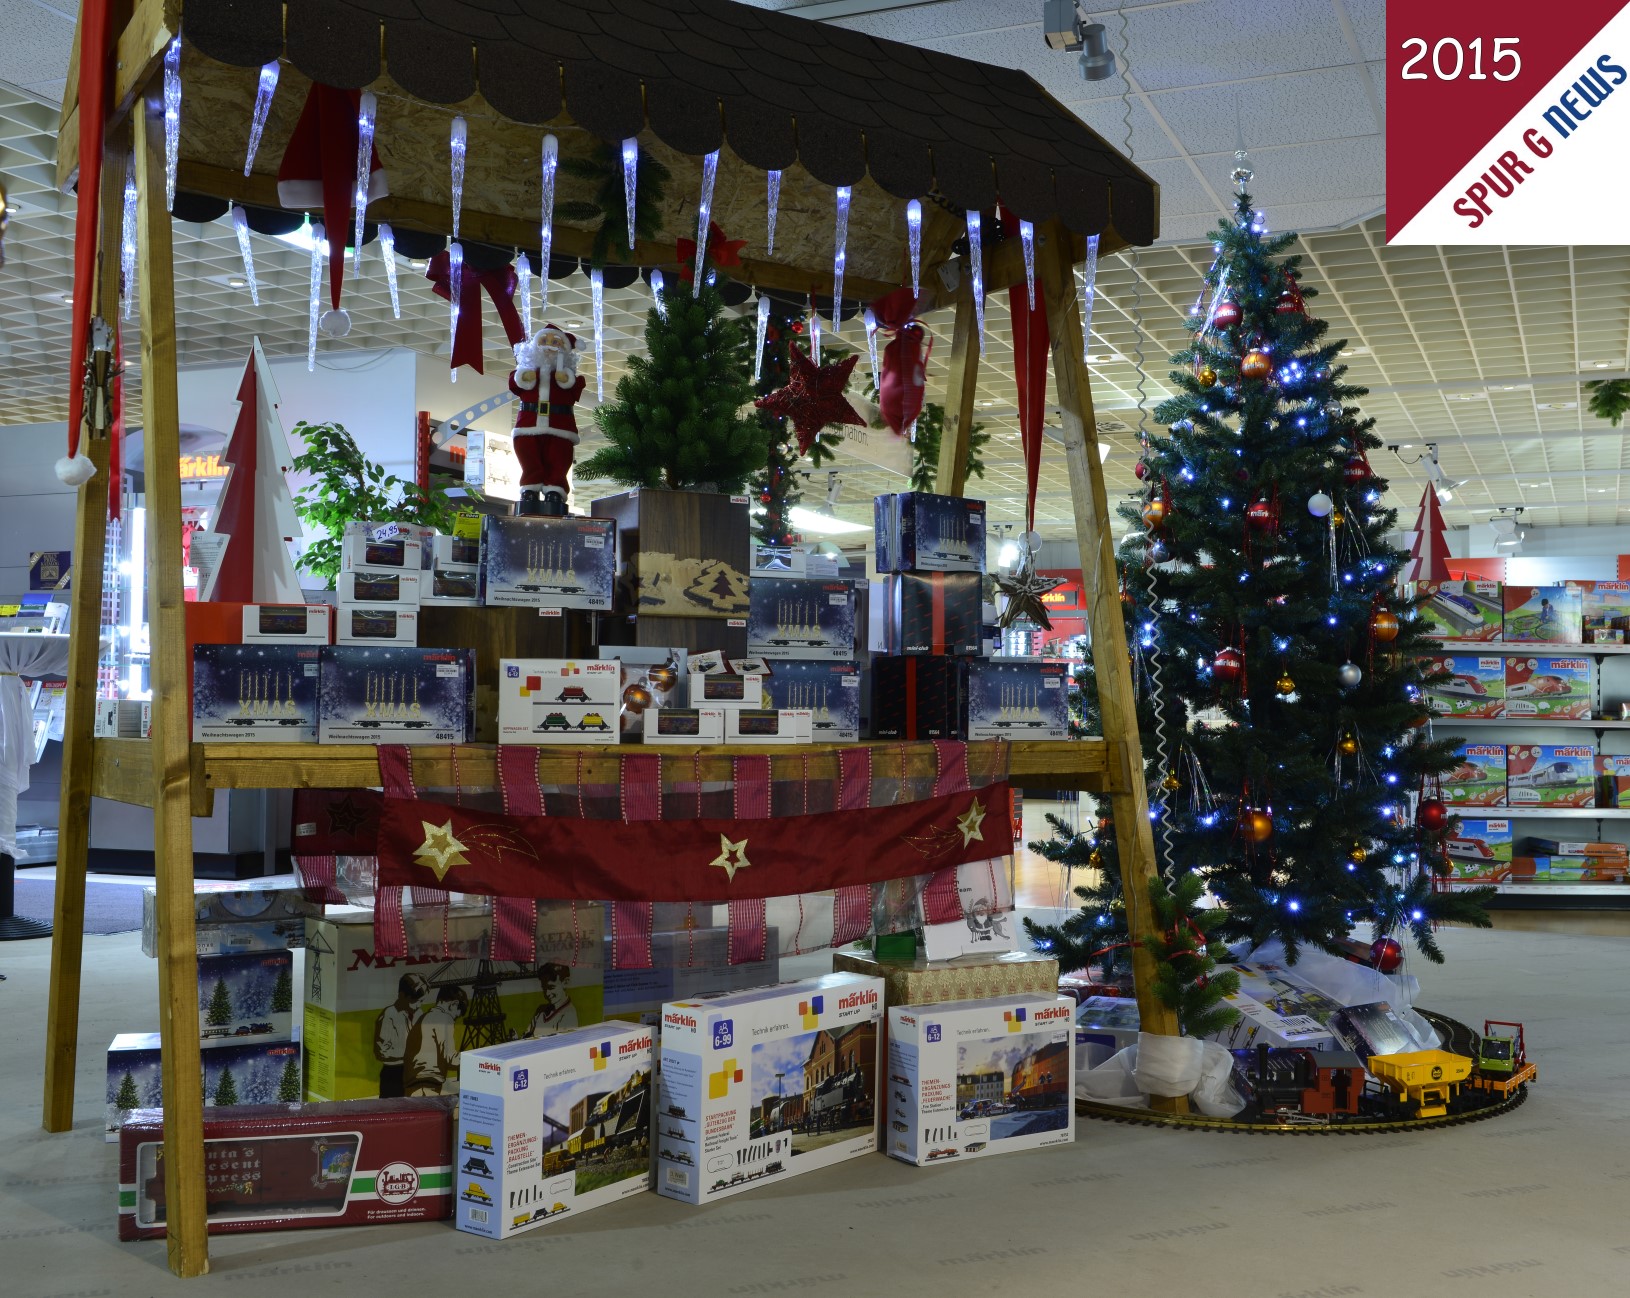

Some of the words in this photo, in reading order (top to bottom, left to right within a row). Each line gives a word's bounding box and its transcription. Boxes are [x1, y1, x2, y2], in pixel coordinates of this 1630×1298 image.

[1041, 594, 1065, 602] ärklin
[1551, 659, 1588, 669] märklin
[239, 700, 296, 717] XMAS
[364, 701, 421, 718] XMAS
[1466, 746, 1504, 755] märklin
[1554, 747, 1592, 757] märklin
[838, 989, 878, 1010] märklin
[838, 1010, 853, 1018] START
[1034, 1006, 1070, 1020] märklin
[665, 1013, 696, 1027] märklin
[715, 1033, 732, 1047] 6-99
[928, 1033, 940, 1041] 6-12
[619, 1036, 652, 1054] märklin
[479, 1061, 501, 1072] märklin
[514, 1079, 528, 1090] 6-12
